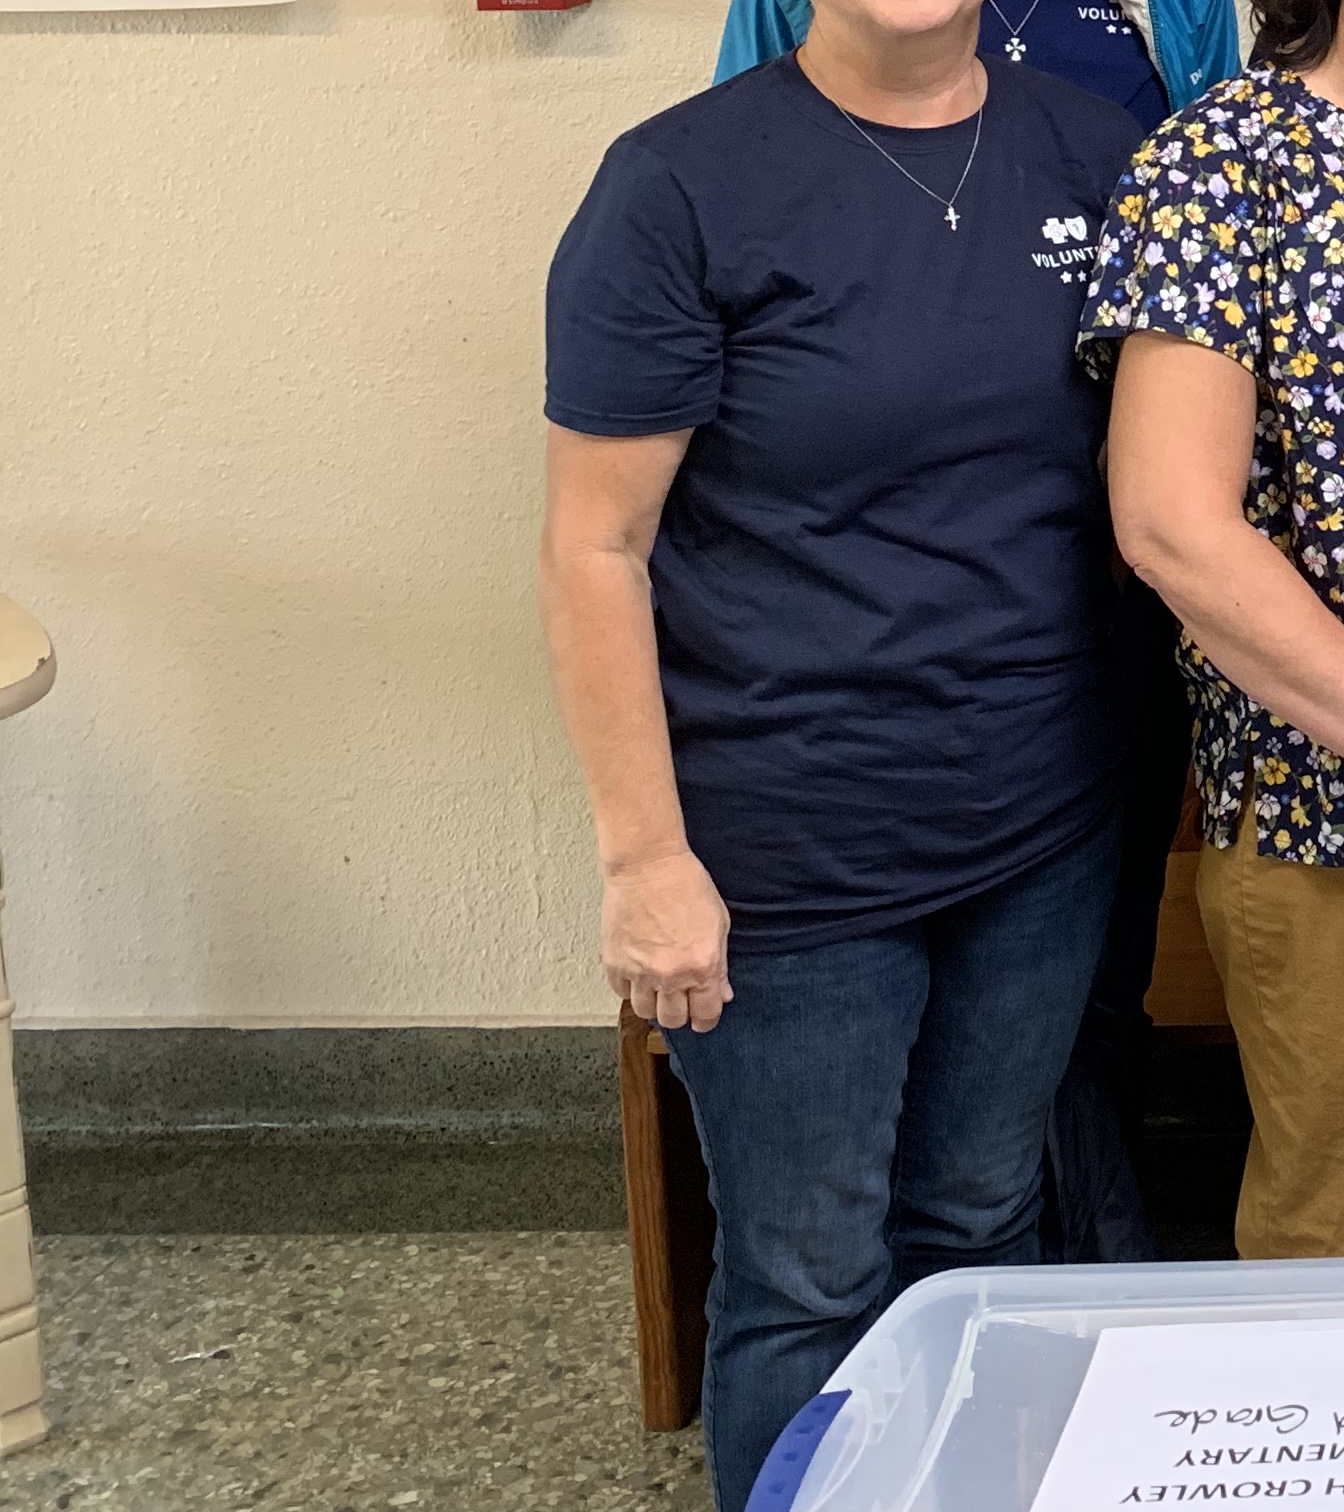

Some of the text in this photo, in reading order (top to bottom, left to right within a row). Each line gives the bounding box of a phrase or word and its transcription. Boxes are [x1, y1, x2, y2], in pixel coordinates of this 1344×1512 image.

[1077, 6, 1126, 21] VOLU
[1153, 1404, 1309, 1434] Grade
[1119, 1477, 1313, 1505] CROWLEY
